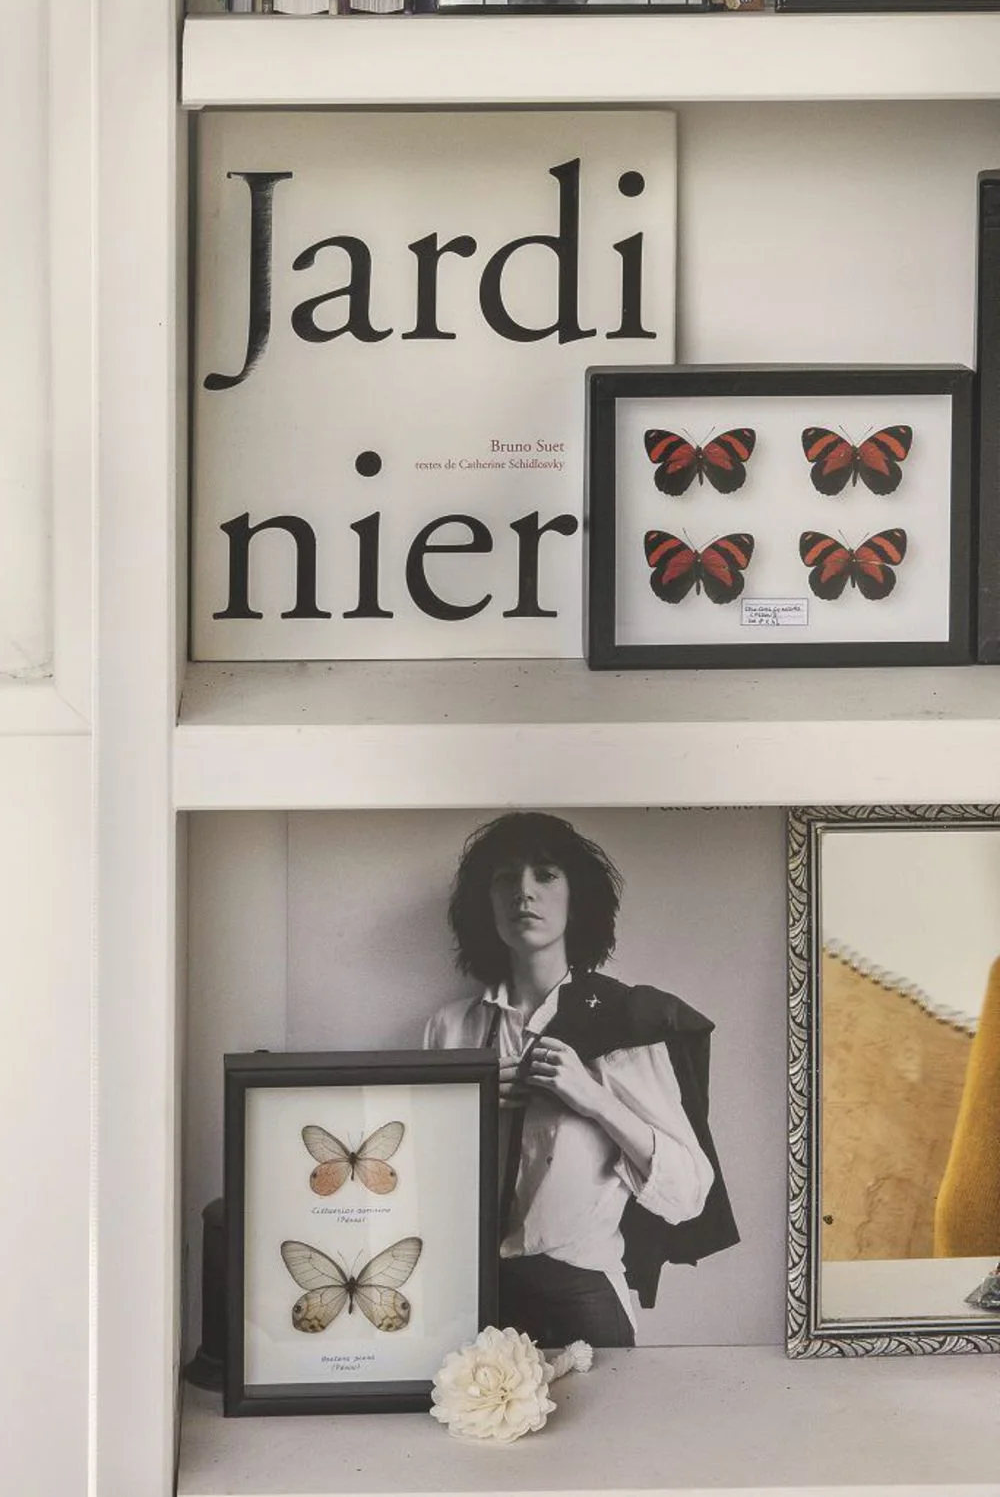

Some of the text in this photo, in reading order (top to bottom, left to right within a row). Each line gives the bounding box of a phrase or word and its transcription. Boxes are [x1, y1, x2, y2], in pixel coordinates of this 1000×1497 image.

[203, 157, 657, 391] Jardi
[415, 459, 442, 470] textes
[444, 458, 457, 470] de
[458, 458, 505, 470] Catherine
[491, 439, 565, 452] Bruno Suet
[212, 451, 579, 621] nier
